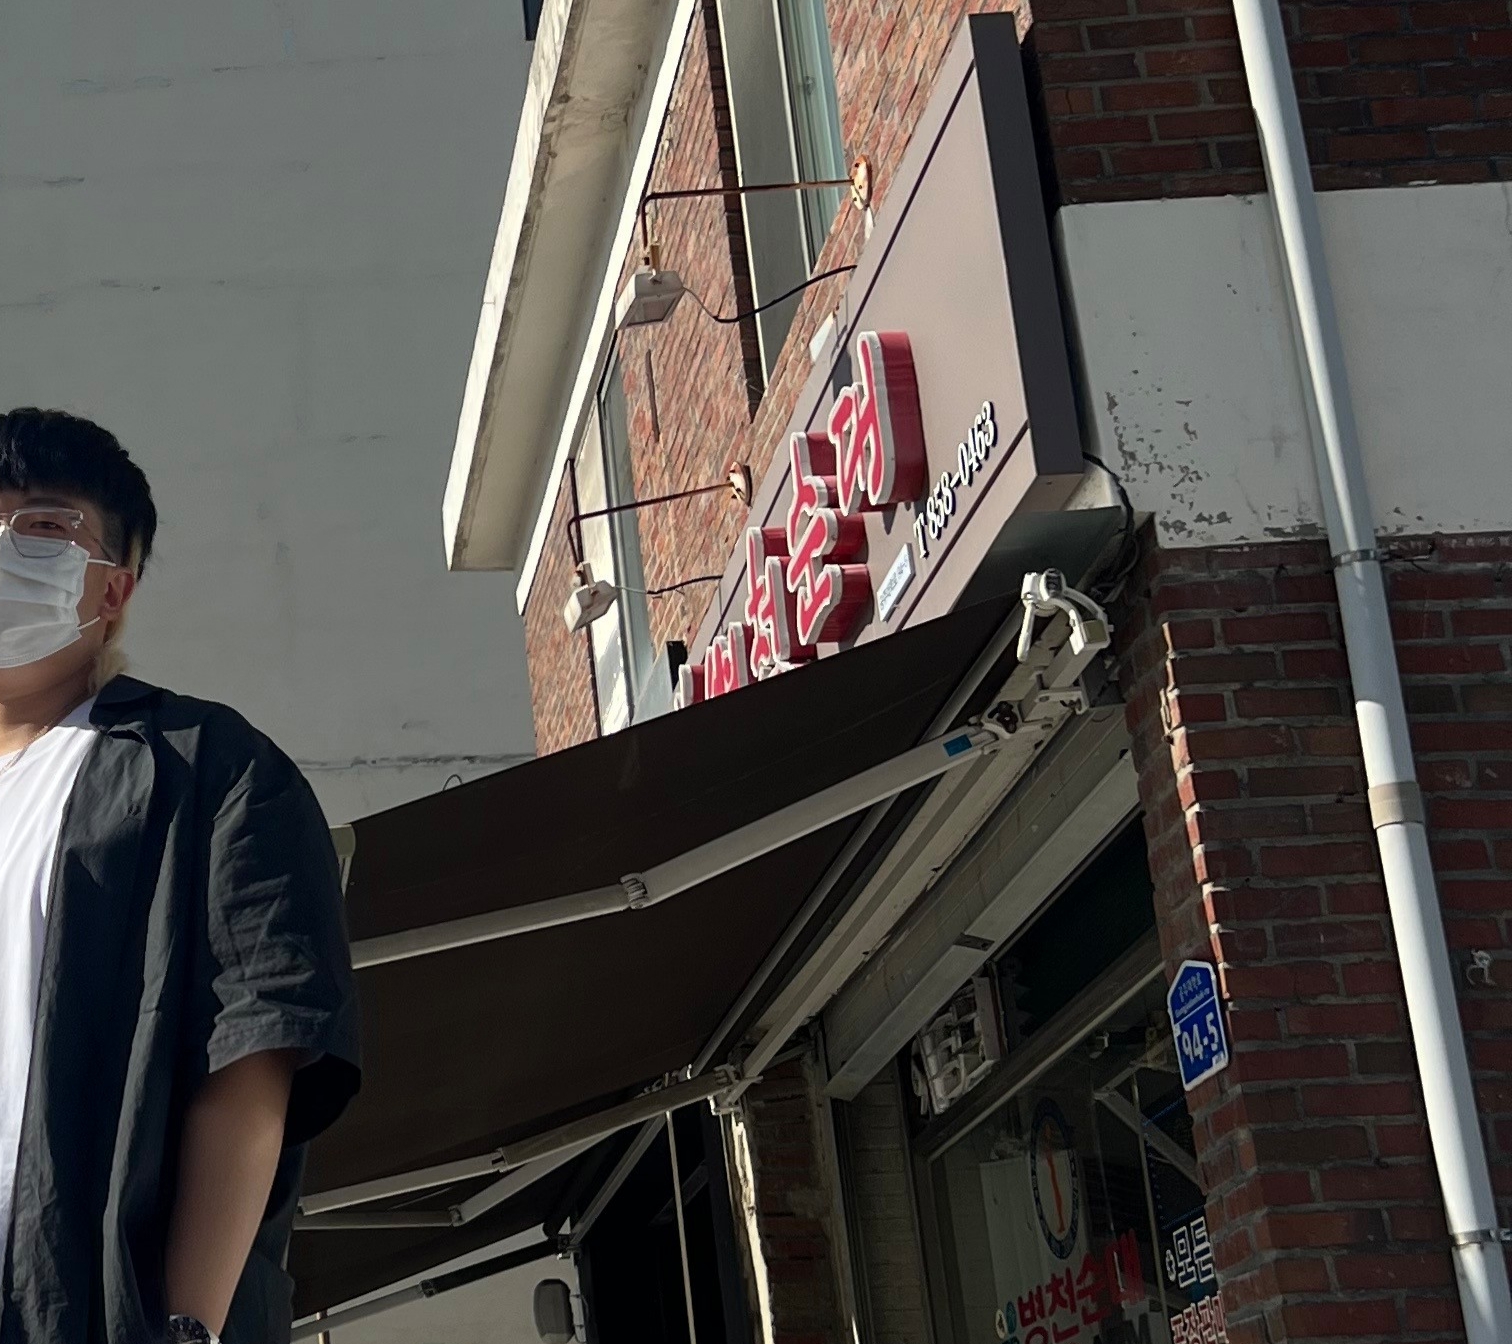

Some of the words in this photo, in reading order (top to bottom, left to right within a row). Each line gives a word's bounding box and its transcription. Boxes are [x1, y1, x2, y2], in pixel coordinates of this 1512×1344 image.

[913, 511, 930, 558] T
[925, 400, 996, 543] 858-0463
[1181, 1011, 1219, 1064] 94-5
